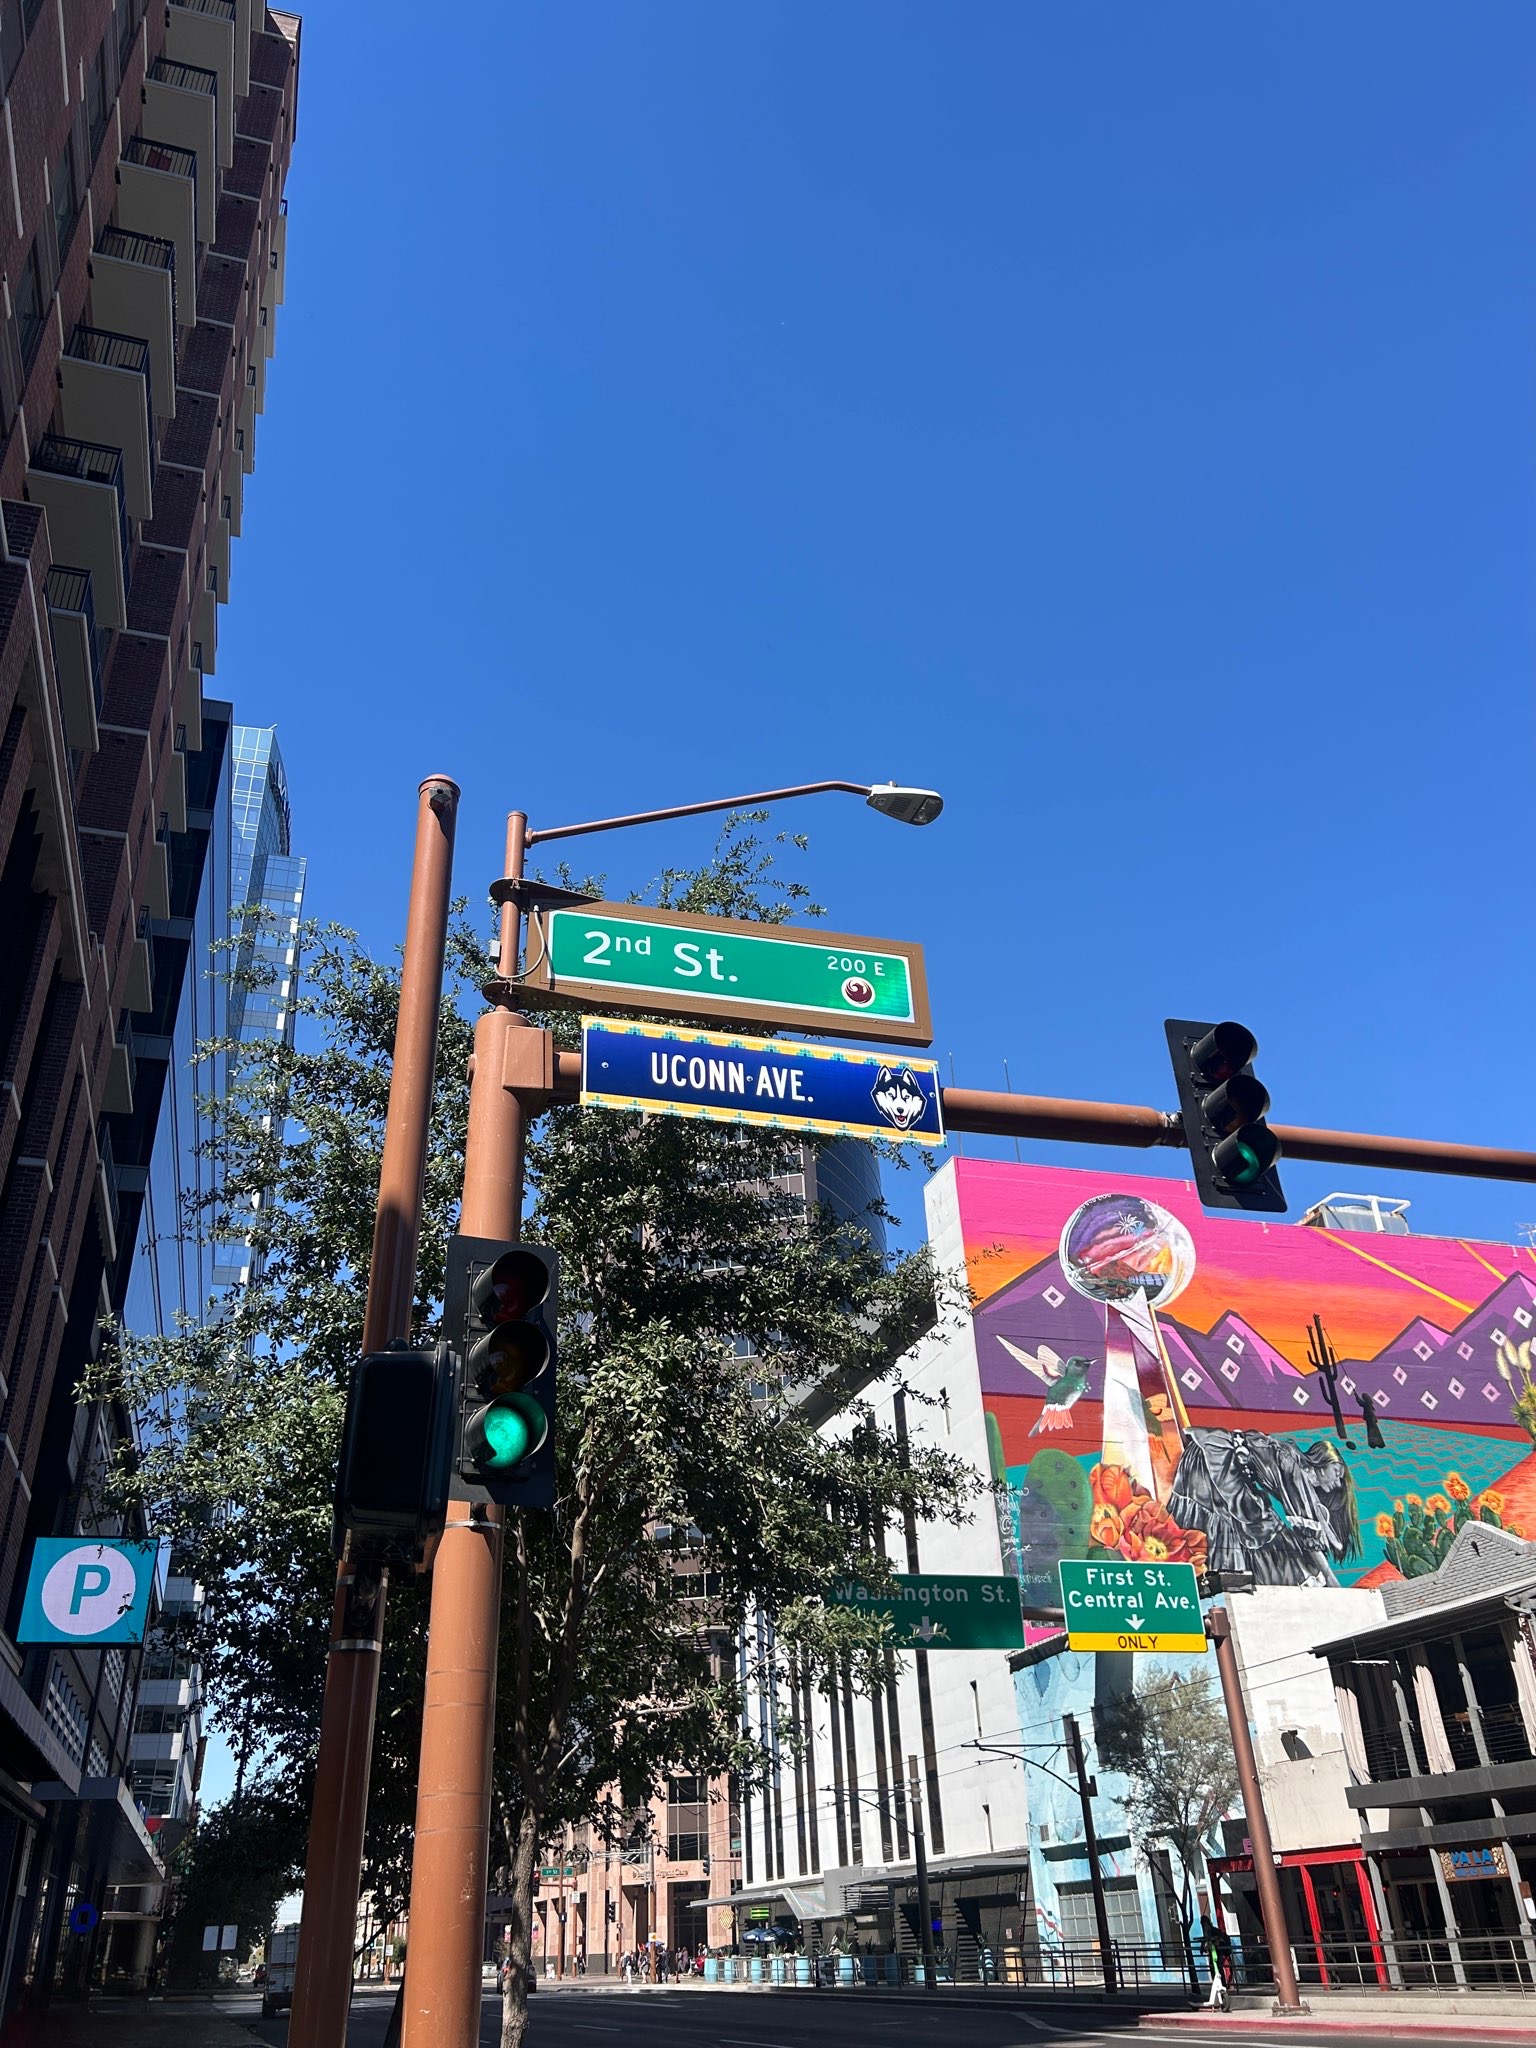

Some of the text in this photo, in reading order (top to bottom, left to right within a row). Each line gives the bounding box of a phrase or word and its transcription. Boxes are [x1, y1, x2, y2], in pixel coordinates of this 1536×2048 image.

[583, 930, 739, 983] 2nd St.
[827, 955, 886, 977] 200 E
[651, 1051, 814, 1103] UCONN AVE.
[1086, 1568, 1171, 1587] First St.
[69, 1564, 111, 1615] P
[981, 1584, 1011, 1604] St.
[1068, 1590, 1196, 1610] Central Ave.
[1117, 1635, 1158, 1649] ONLY
